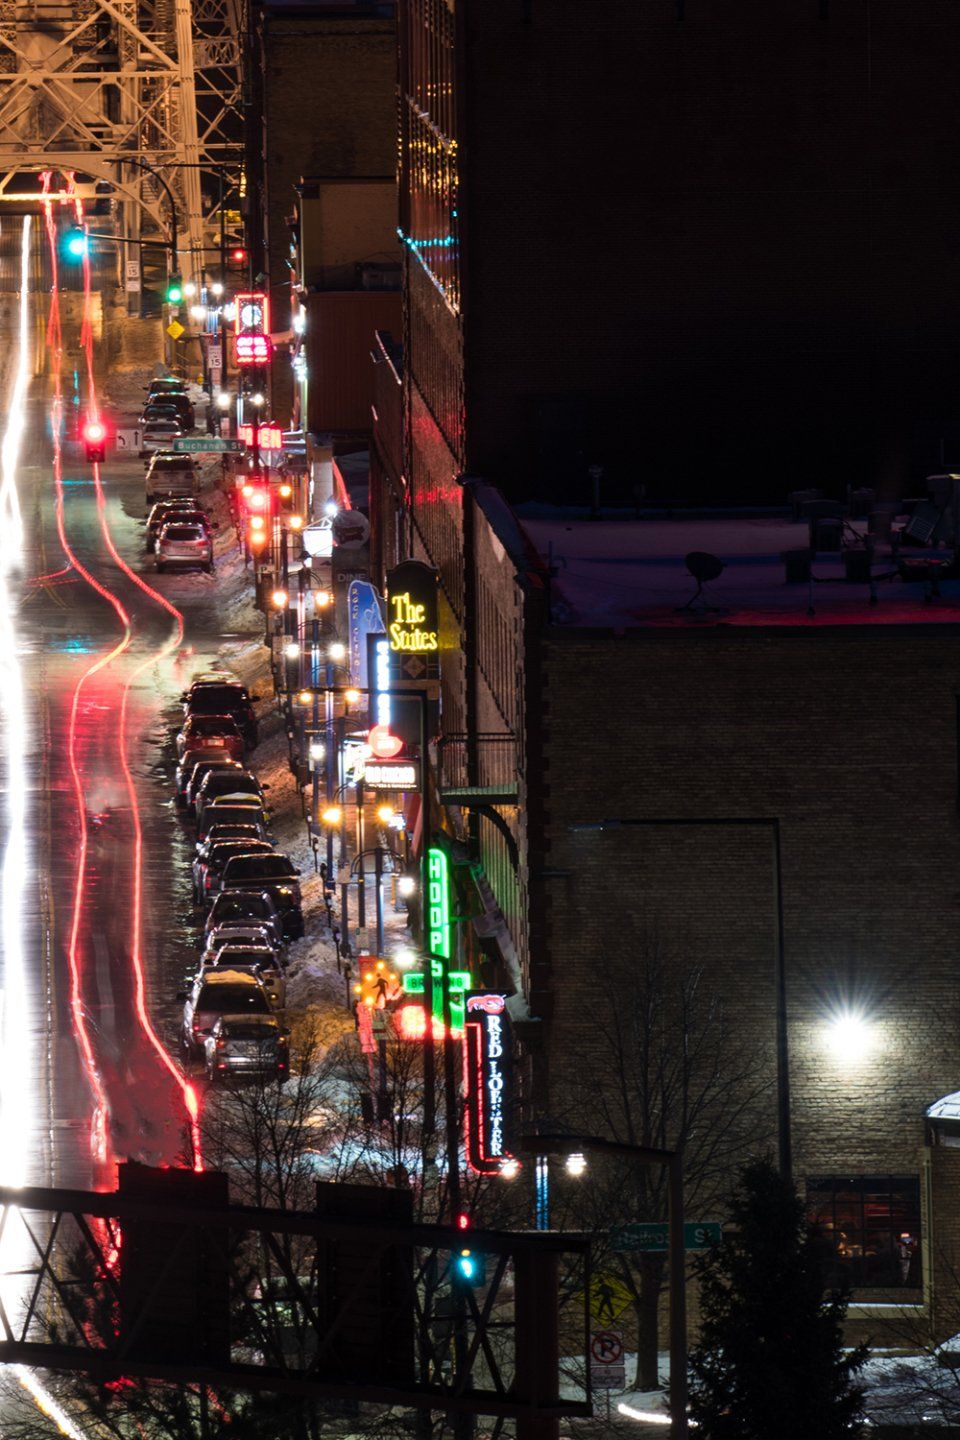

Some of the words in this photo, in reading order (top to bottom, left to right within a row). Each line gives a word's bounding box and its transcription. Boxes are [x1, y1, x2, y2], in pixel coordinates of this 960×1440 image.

[210, 358, 221, 367] 15
[178, 442, 228, 450] Buchanan
[231, 442, 243, 450] St
[391, 592, 426, 624] The
[390, 623, 438, 651] Suites
[487, 1015, 503, 1058] RED
